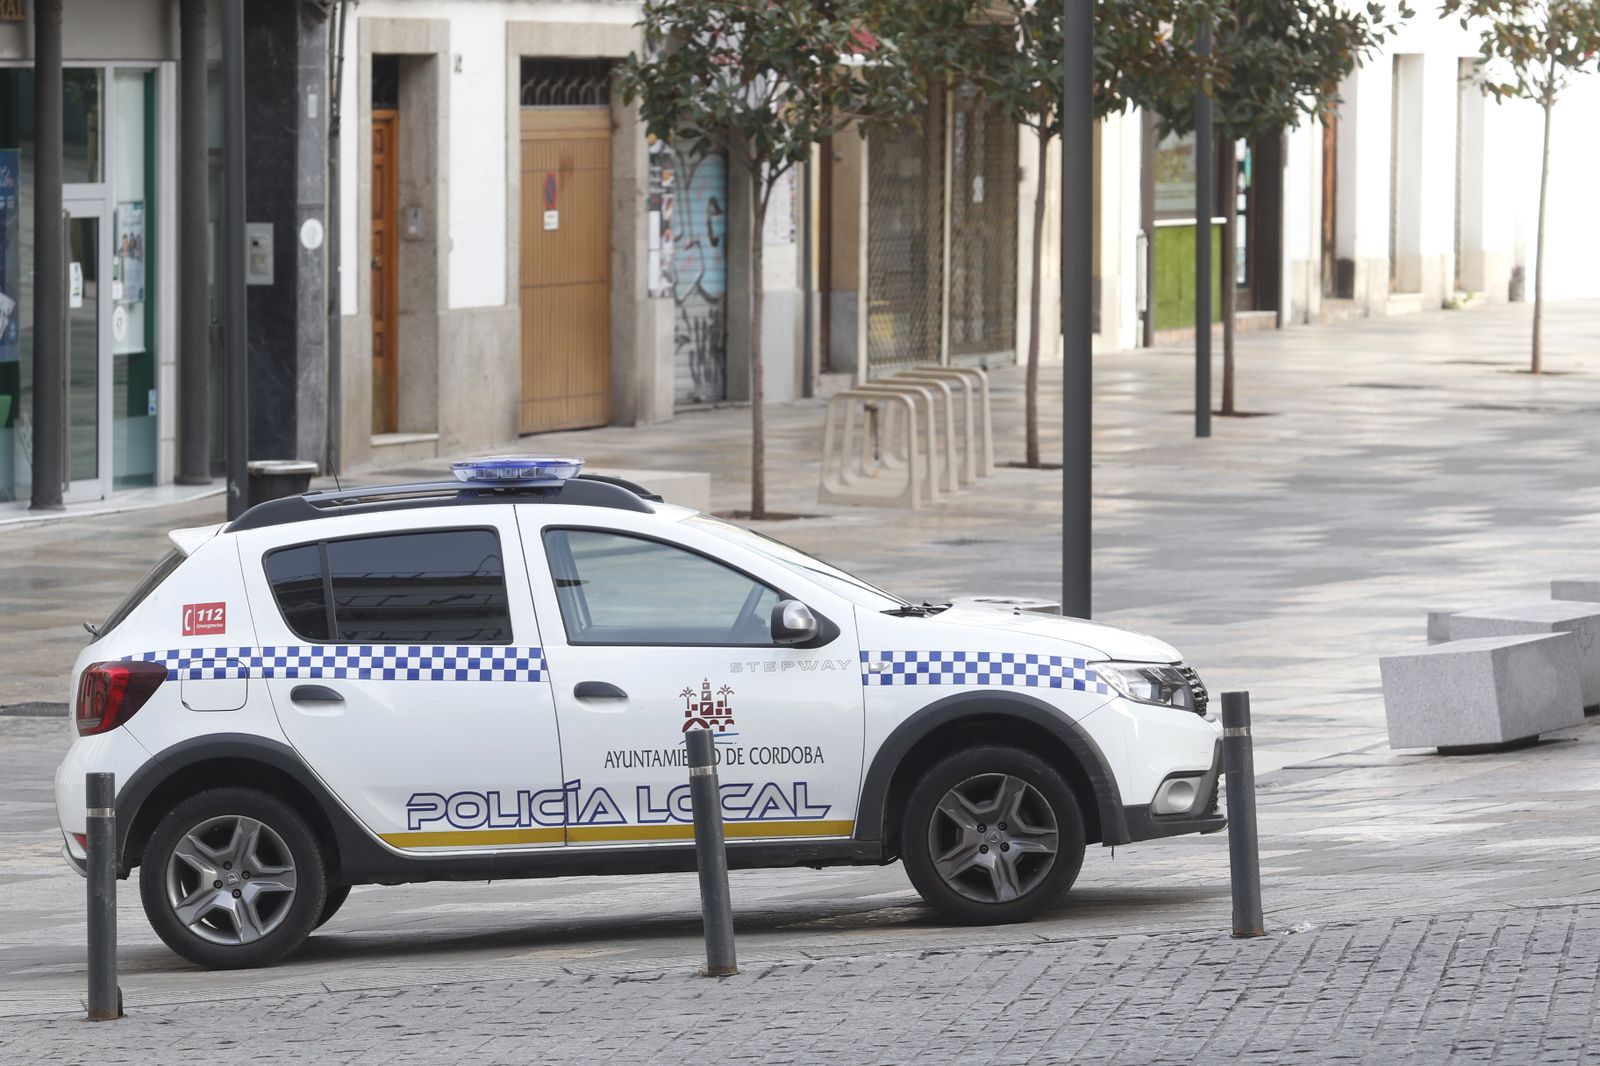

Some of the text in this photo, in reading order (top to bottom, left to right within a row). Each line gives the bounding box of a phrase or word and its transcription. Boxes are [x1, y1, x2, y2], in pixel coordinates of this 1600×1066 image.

[197, 607, 224, 621] 112
[730, 659, 852, 673] STEPWAY
[604, 746, 825, 769] AYUNTAMIEO DE CORDOBA
[406, 780, 832, 830] POLICÍA LOCAL
